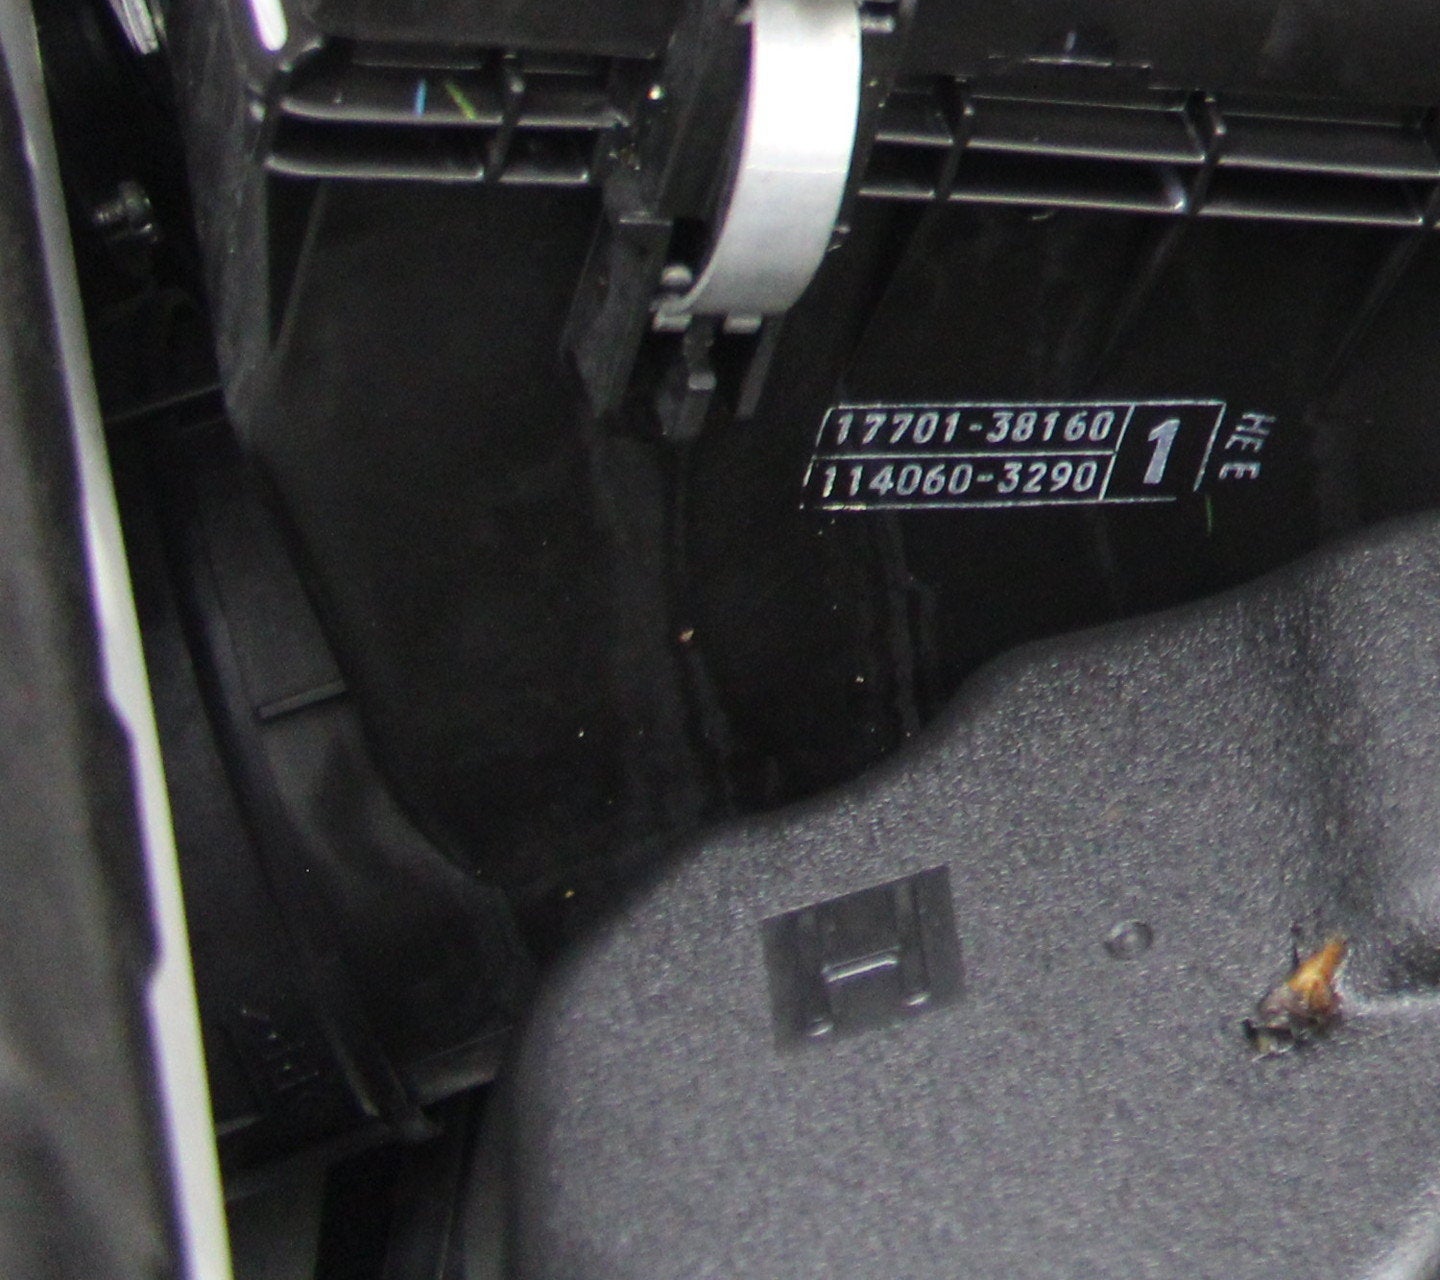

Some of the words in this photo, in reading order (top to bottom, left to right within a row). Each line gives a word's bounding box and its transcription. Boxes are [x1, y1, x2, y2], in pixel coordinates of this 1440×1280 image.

[834, 410, 1116, 445] 17701-38160
[1143, 417, 1181, 485] 1
[821, 460, 1098, 498] 114060-3290
